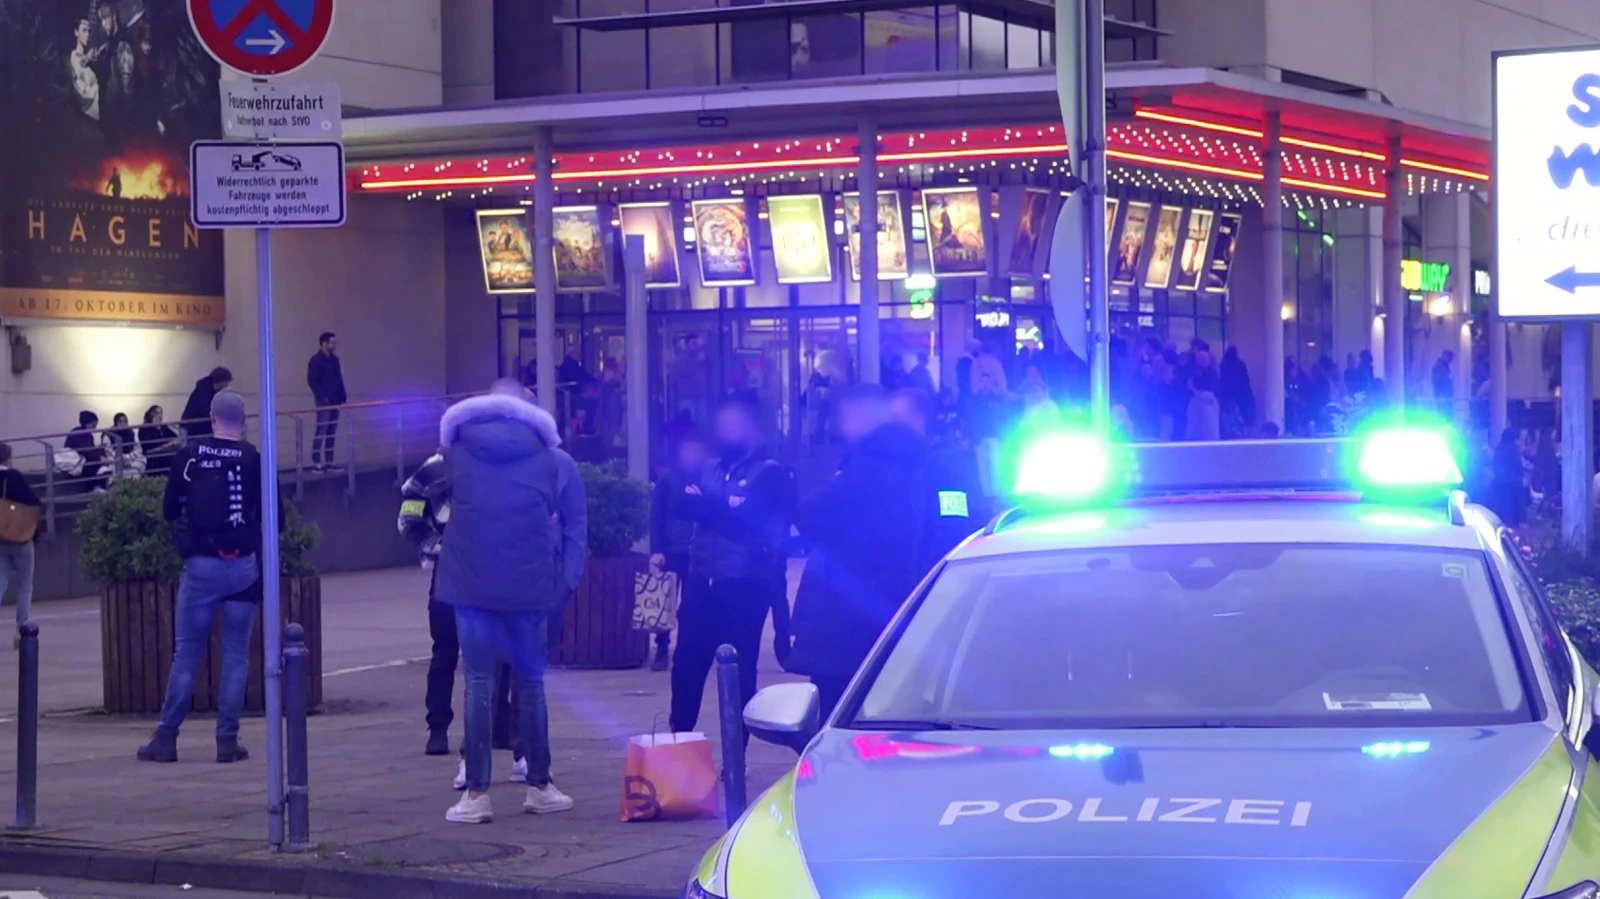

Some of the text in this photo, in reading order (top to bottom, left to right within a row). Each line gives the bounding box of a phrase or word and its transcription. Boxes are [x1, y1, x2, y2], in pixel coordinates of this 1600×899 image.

[228, 92, 324, 110] Feuerwehrzufahrt
[268, 115, 287, 126] nach
[291, 116, 311, 126] StVO
[217, 176, 319, 189] Widerrechtlich geparkte
[228, 190, 306, 202] Fahrzeuge werden
[207, 203, 330, 216] kostenpflichtig abgeschleppt
[28, 210, 199, 248] HAGEN
[19, 297, 212, 316] AB 17. OKTOBER IM KINO
[938, 797, 1312, 826] POLIZEI
